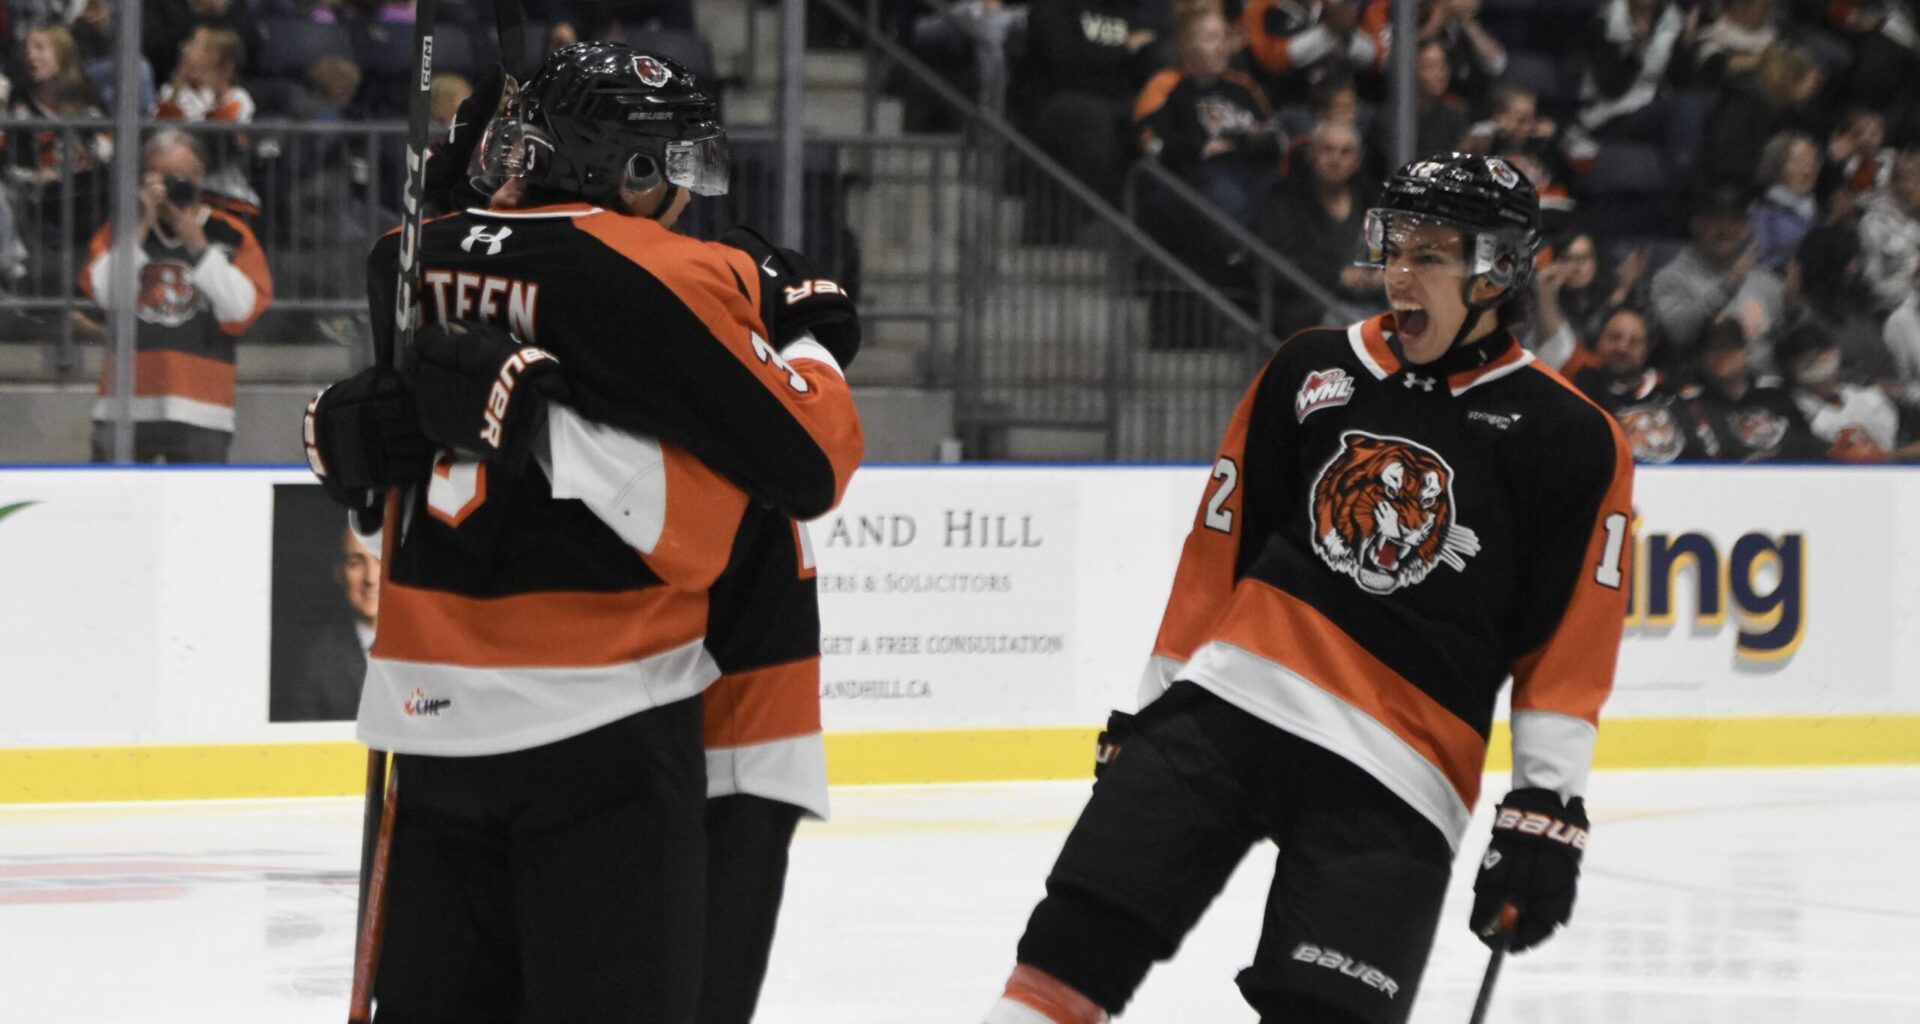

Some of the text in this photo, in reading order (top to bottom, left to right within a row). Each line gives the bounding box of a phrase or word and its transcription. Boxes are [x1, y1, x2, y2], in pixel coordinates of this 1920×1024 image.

[422, 39, 431, 87] CCM
[419, 270, 539, 345] TEEN
[480, 348, 559, 449] AUER
[1204, 455, 1238, 534] 2
[826, 510, 1043, 548] AND HILL
[1595, 511, 1628, 591] 1
[882, 571, 1012, 593] SOLICITORS
[821, 633, 1064, 655] GET A FREE CONSULTATION
[1291, 942, 1400, 1000] BAUER
